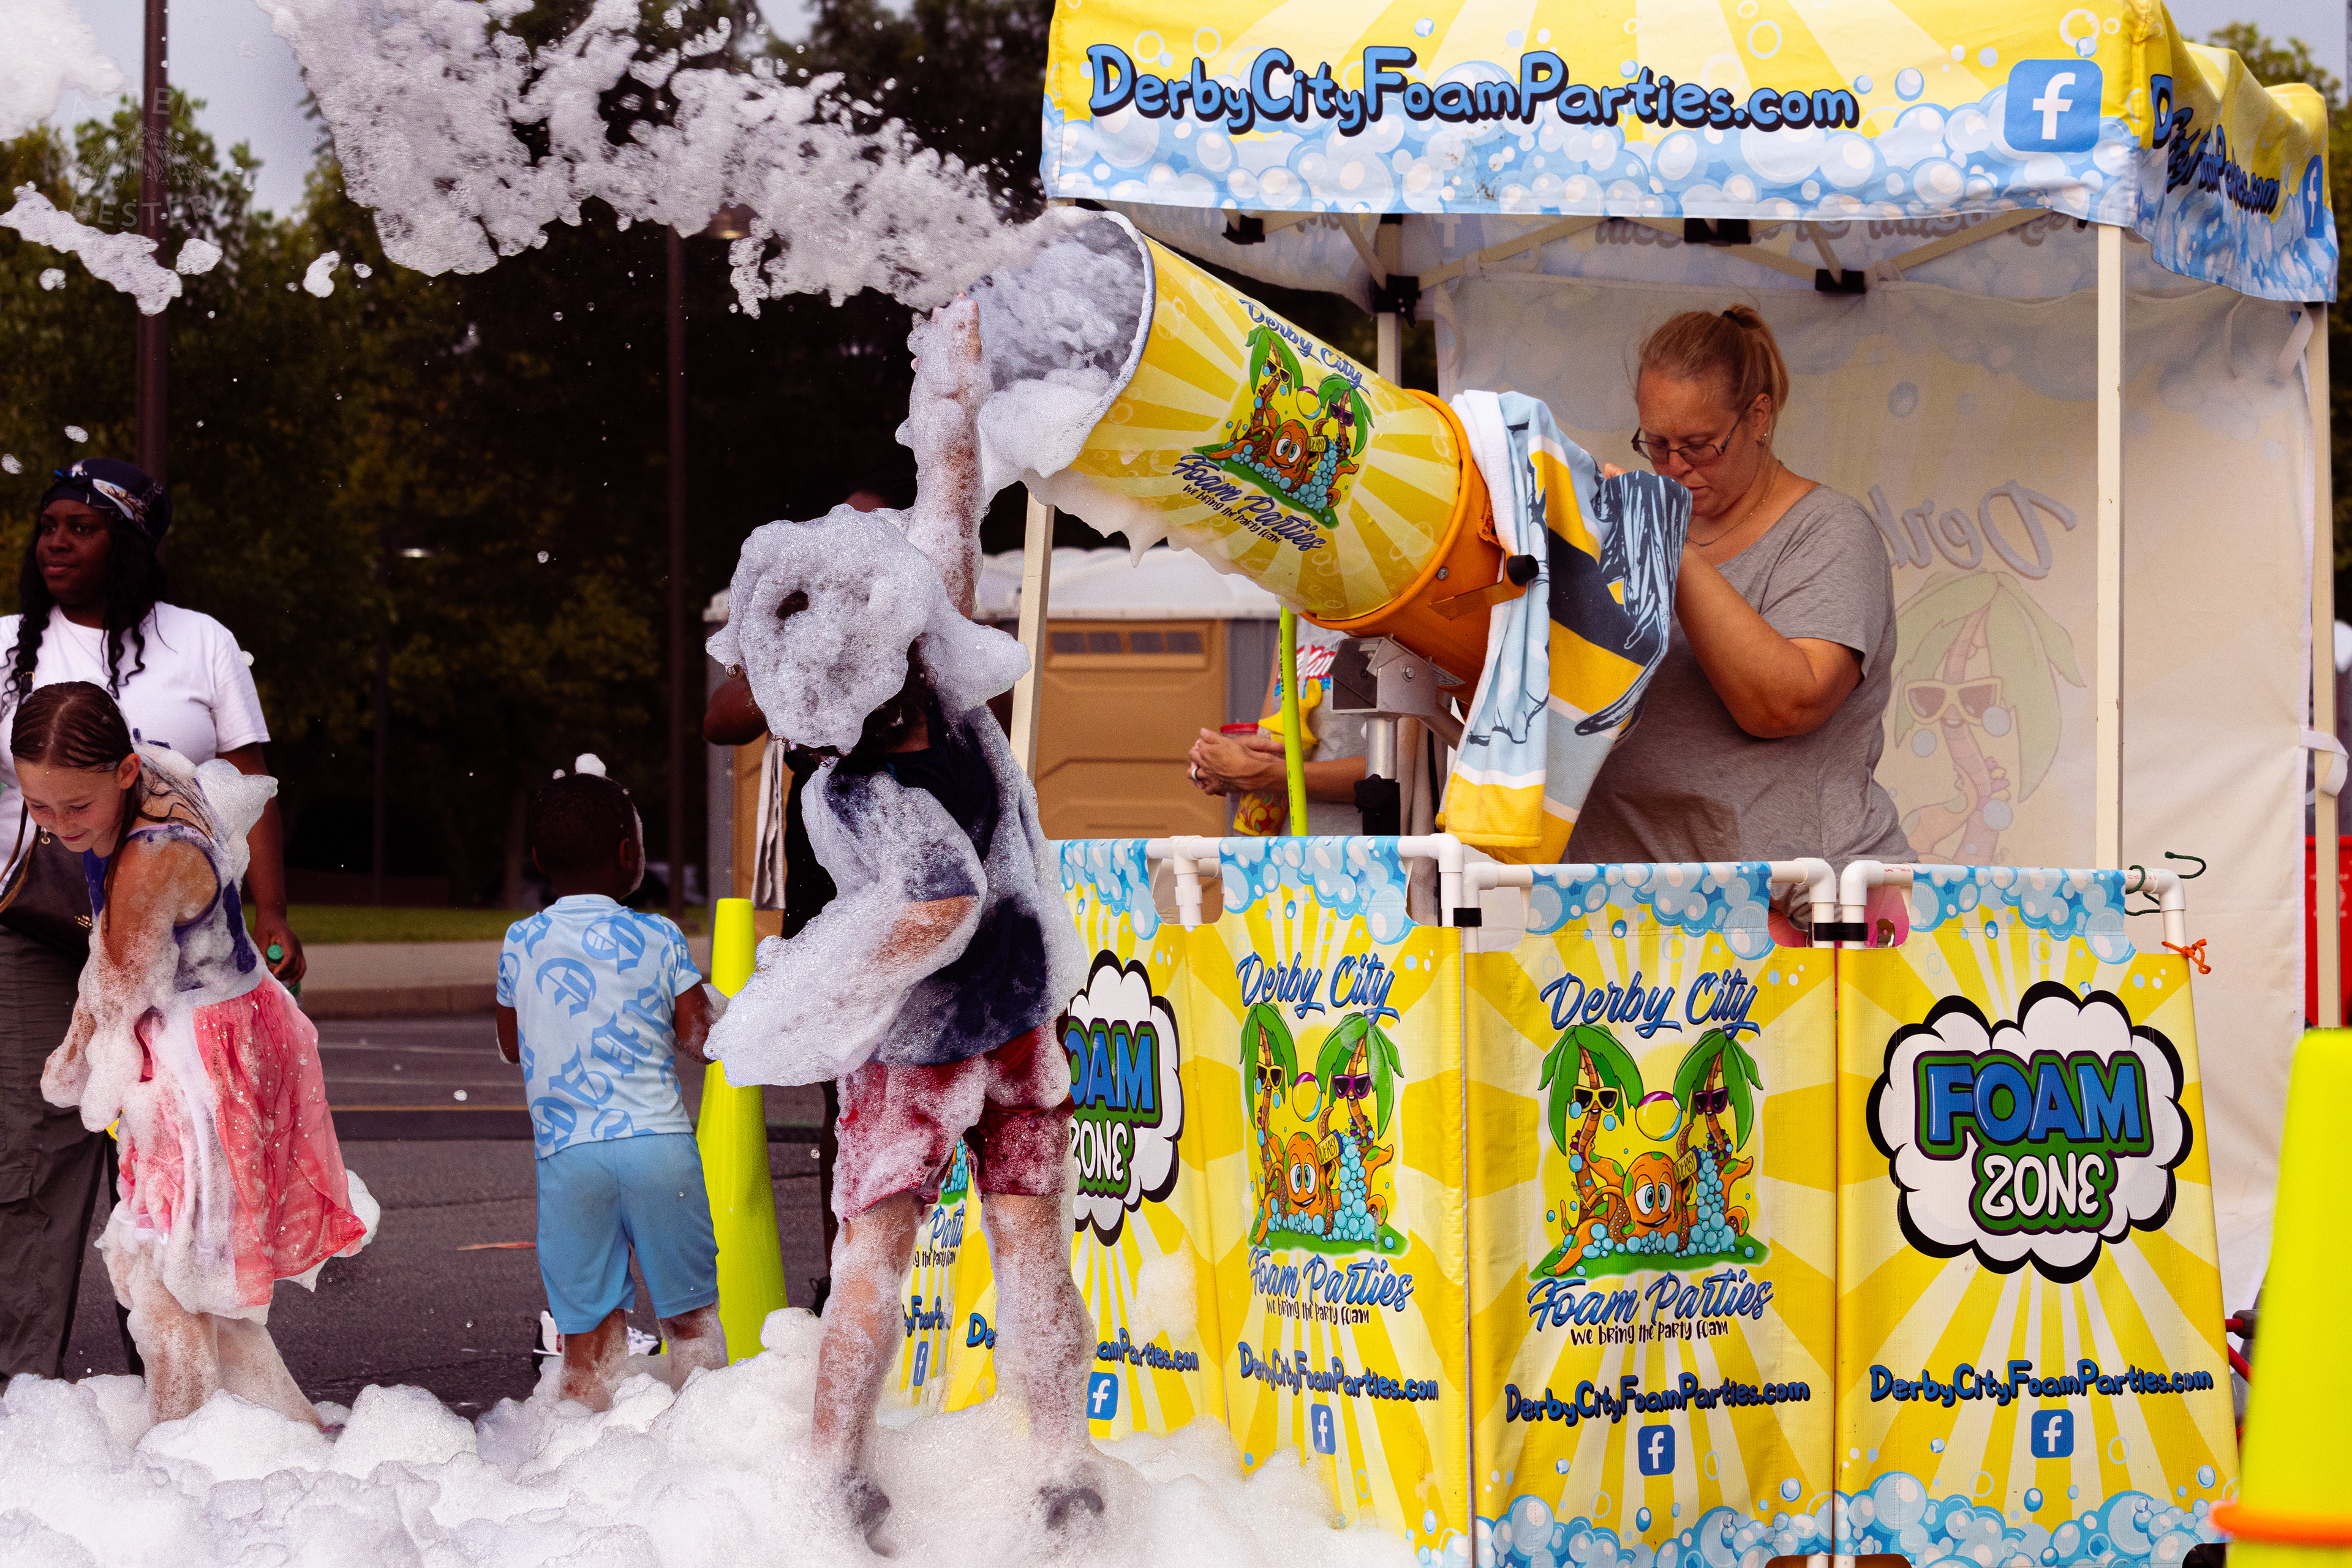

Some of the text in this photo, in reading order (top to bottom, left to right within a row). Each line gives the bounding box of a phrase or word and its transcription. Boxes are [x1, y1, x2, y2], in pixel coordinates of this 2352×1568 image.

[1086, 43, 1860, 137] DerbyCityFoamParties.com
[1238, 299, 1371, 397] Derby City
[1308, 437, 1325, 451] DERBY
[1172, 454, 1327, 552] Foam Parties
[1221, 505, 1241, 522] the
[1236, 951, 1400, 1025] Derby City
[1540, 968, 1761, 1039] Derby City
[1064, 1028, 1155, 1112] OAM
[1924, 1061, 2144, 1144] FOAM
[1320, 1136, 1339, 1164] DERBY
[1676, 1152, 1695, 1181] DERBY
[1980, 1154, 2107, 1218] ZONE
[1246, 1246, 1415, 1312] Foam Parties
[1526, 1268, 1775, 1332] Foam Parties
[1302, 1302, 1314, 1320] the
[1638, 1323, 1655, 1343] the
[1096, 1327, 1200, 1373] amParties.com
[1237, 1341, 1439, 1402] DerbyCityFoamParties.com
[1504, 1371, 1811, 1427] DerbyCityFoamParties.com
[1869, 1358, 2214, 1408] DerbyCityFoamParties.com
